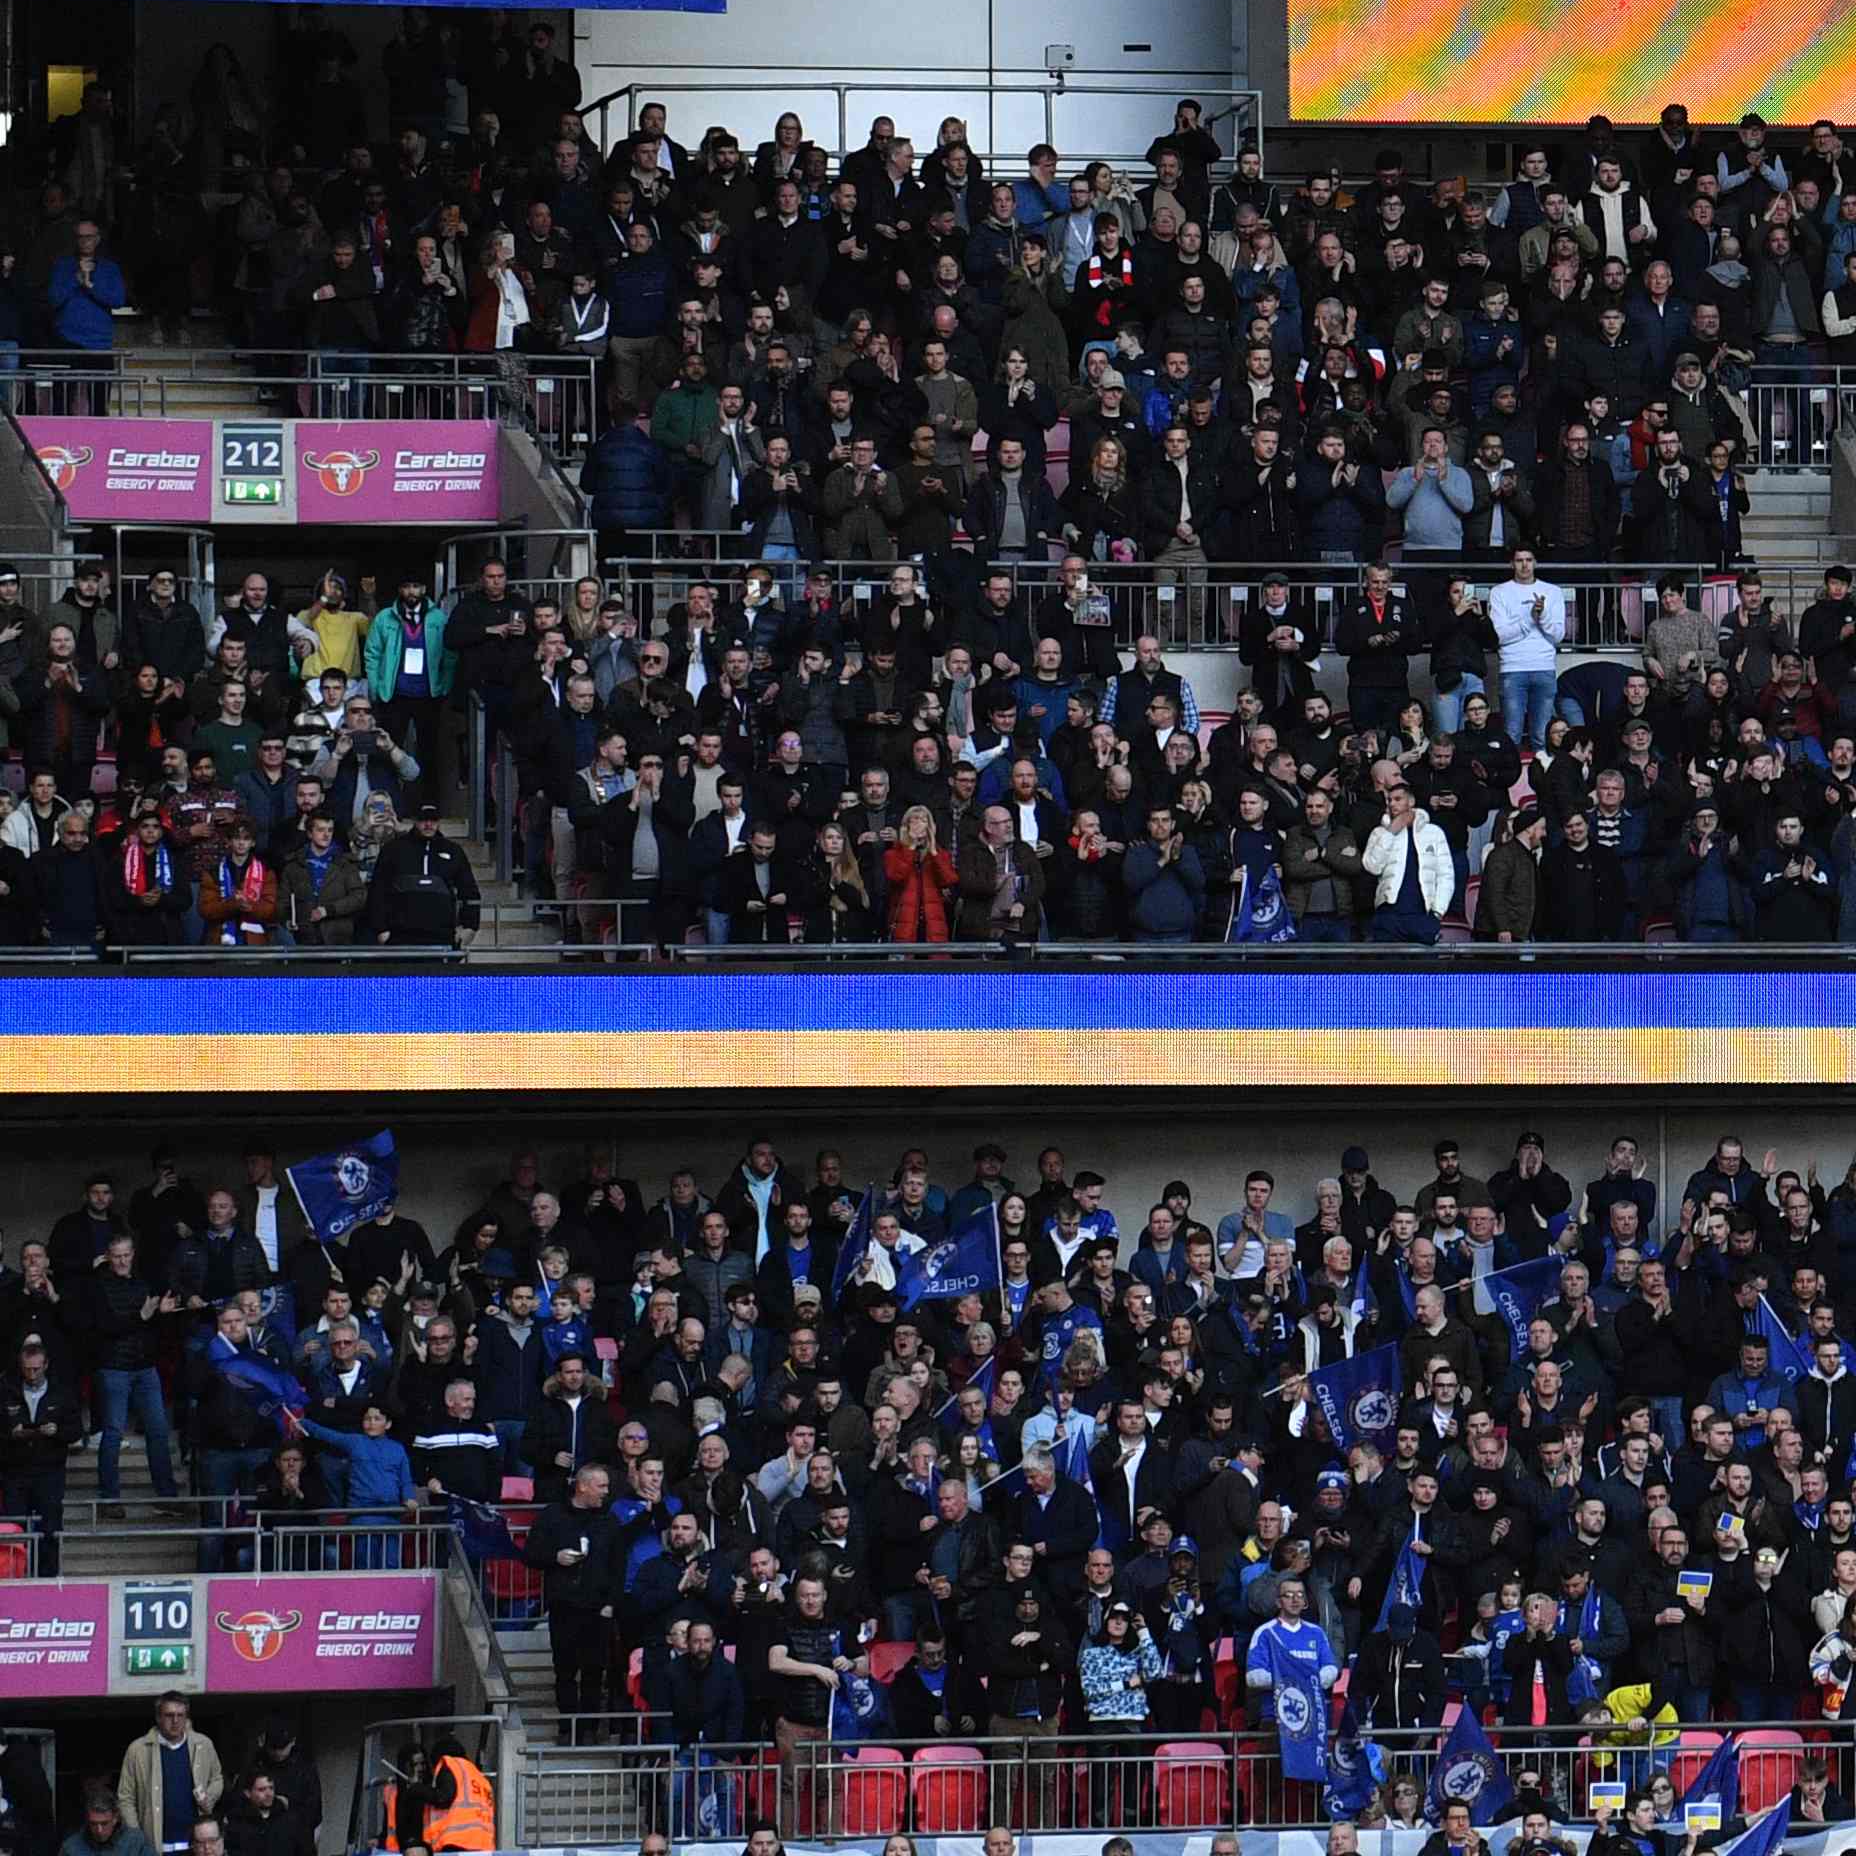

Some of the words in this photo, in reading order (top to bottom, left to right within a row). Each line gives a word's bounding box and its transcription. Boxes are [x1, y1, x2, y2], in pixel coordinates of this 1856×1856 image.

[107, 448, 201, 469] Carabao
[226, 441, 280, 467] 212
[395, 450, 486, 469] Carabao
[106, 478, 156, 492] ENERGY
[157, 478, 196, 493] DRINK
[394, 478, 442, 492] ENERGY
[444, 478, 482, 492] DRINK
[1499, 1291, 1529, 1355] CHELSEA
[128, 1600, 188, 1631] 110
[318, 1610, 422, 1633] Carabao
[48, 1650, 90, 1665] DRINK
[316, 1643, 371, 1657] ENERGY
[373, 1643, 417, 1657] DRINK
